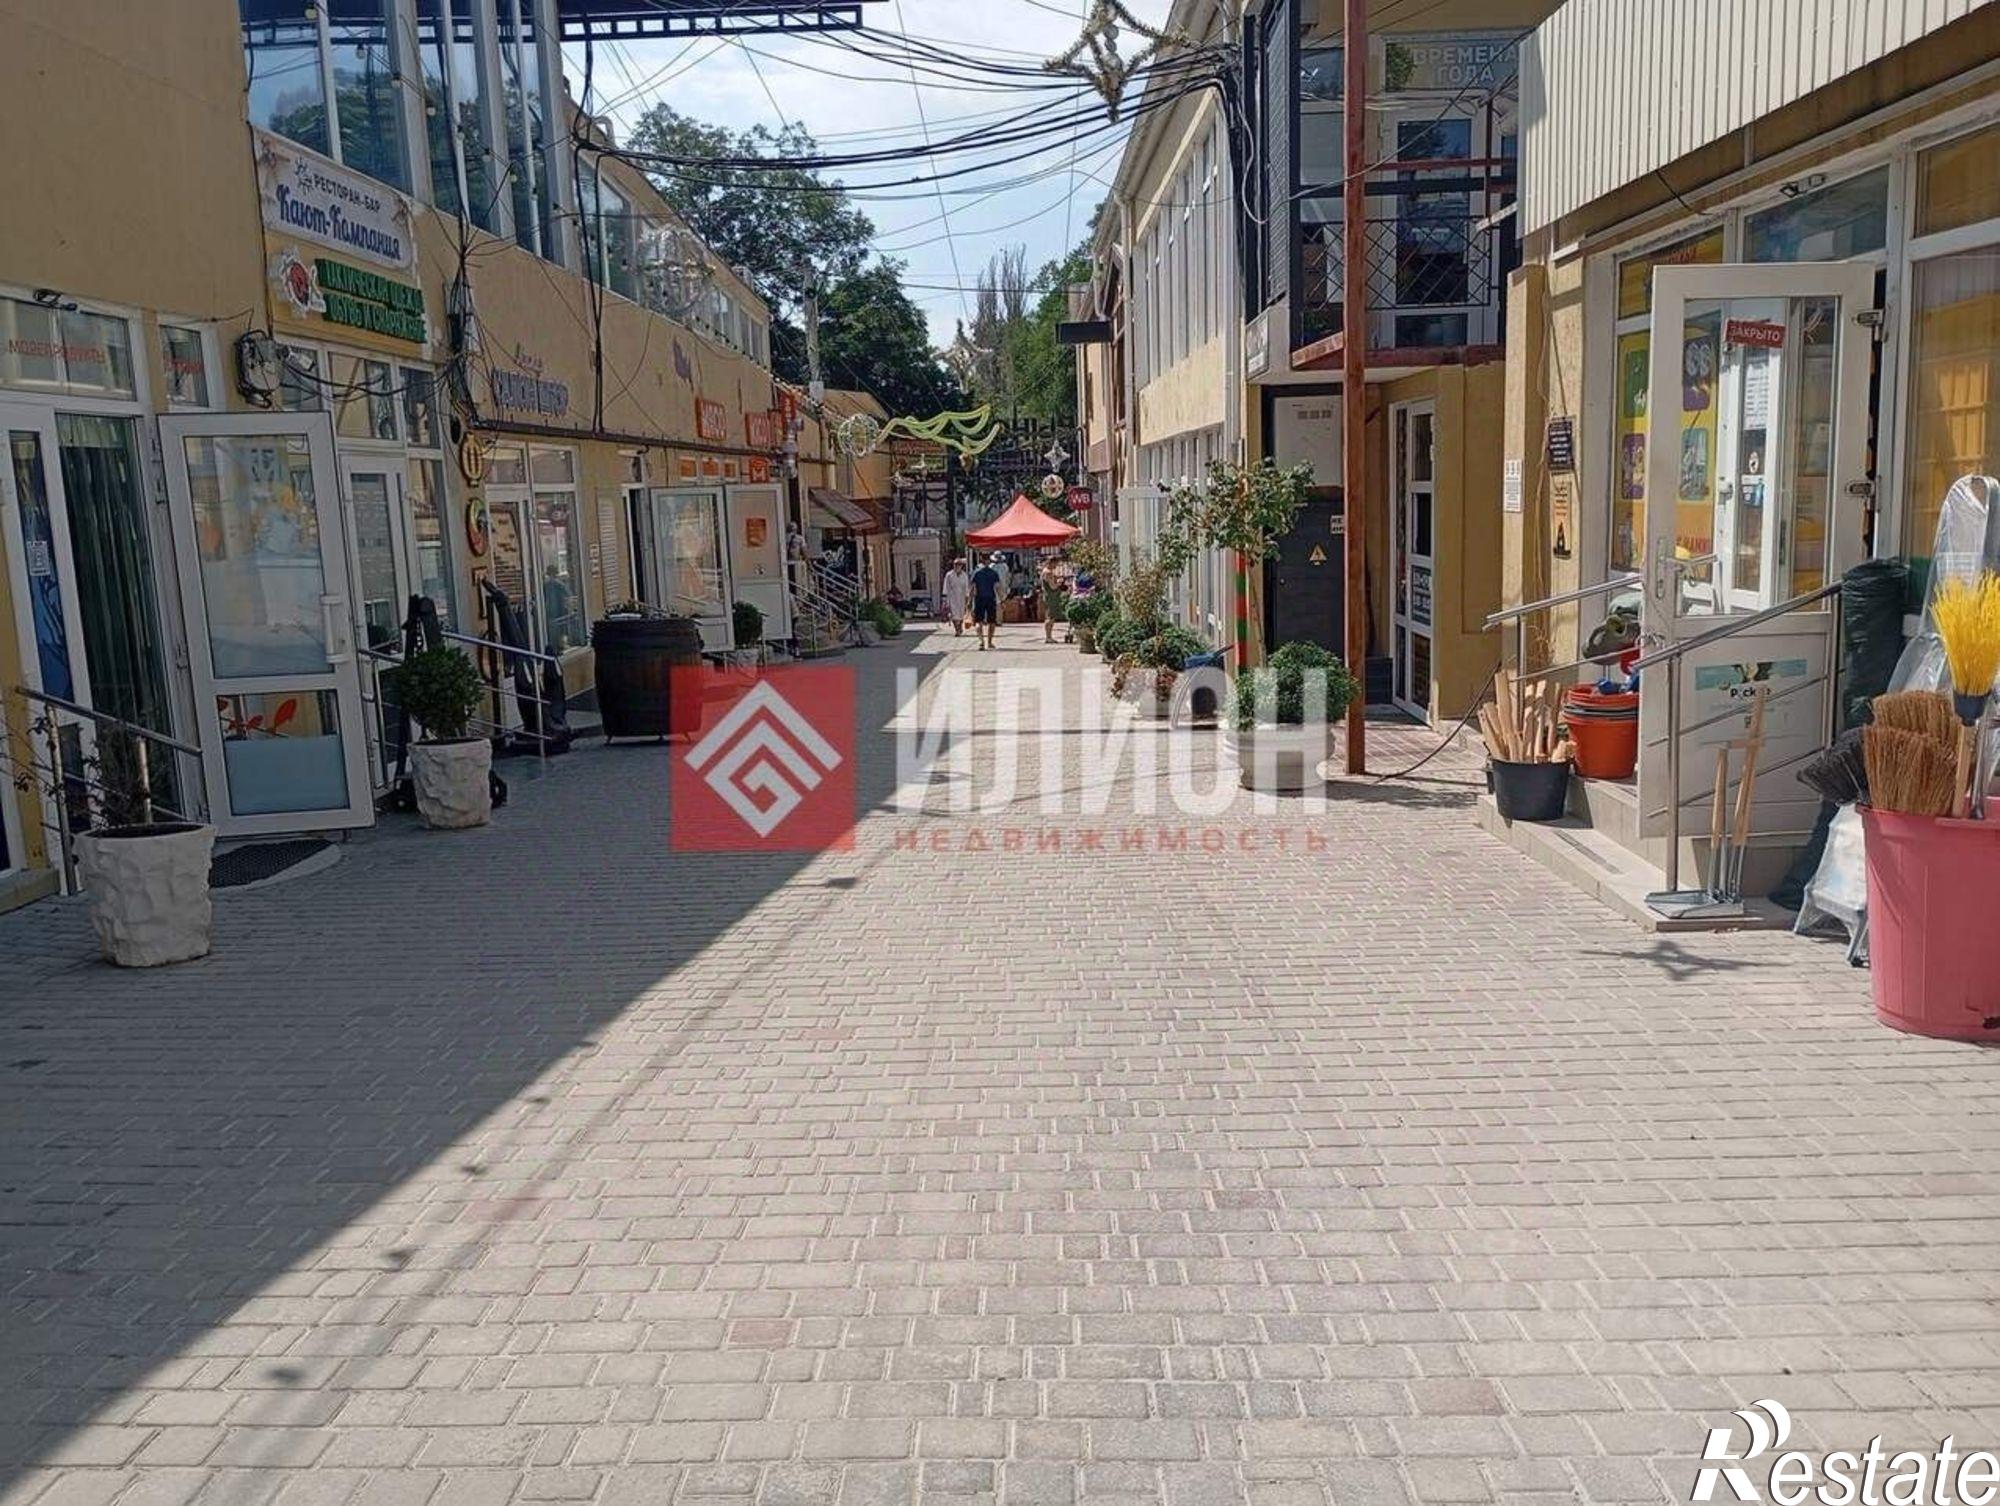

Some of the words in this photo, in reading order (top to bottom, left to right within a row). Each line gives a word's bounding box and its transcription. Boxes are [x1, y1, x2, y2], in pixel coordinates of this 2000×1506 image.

[1412, 45, 1518, 65] ВРЕМЕНА
[1437, 65, 1495, 84] ГОДА
[313, 174, 381, 213] РЕСТОРАН-БАР
[276, 184, 402, 261] Кают-Компания
[1730, 324, 1781, 343] ЗАКРЫТО
